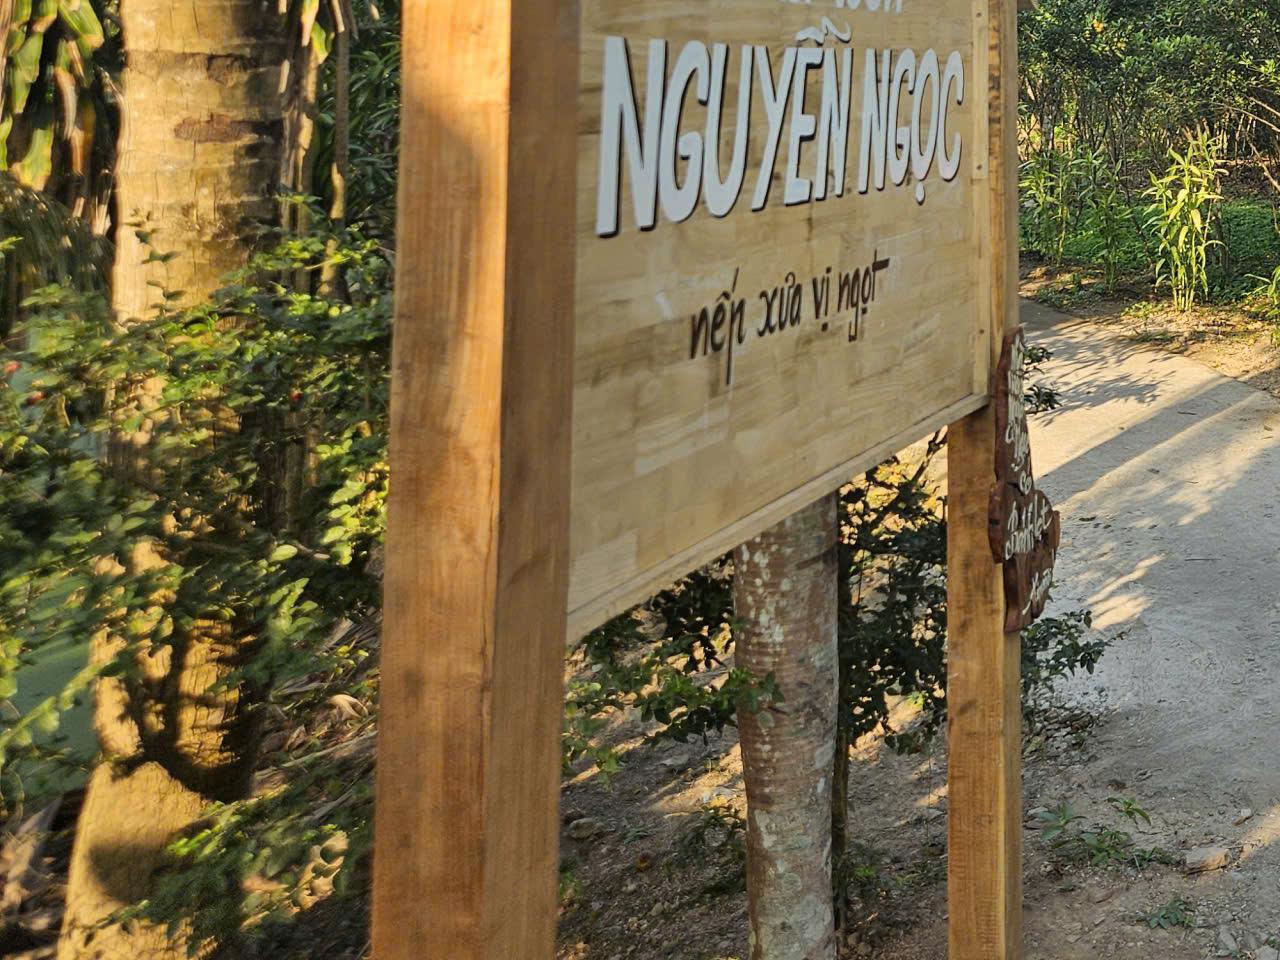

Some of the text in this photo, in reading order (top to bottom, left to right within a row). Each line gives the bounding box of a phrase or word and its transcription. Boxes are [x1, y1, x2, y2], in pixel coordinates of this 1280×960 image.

[596, 16, 964, 237] NGUYỄN NGỌC
[689, 249, 890, 386] nếp xưa vị ngọt
